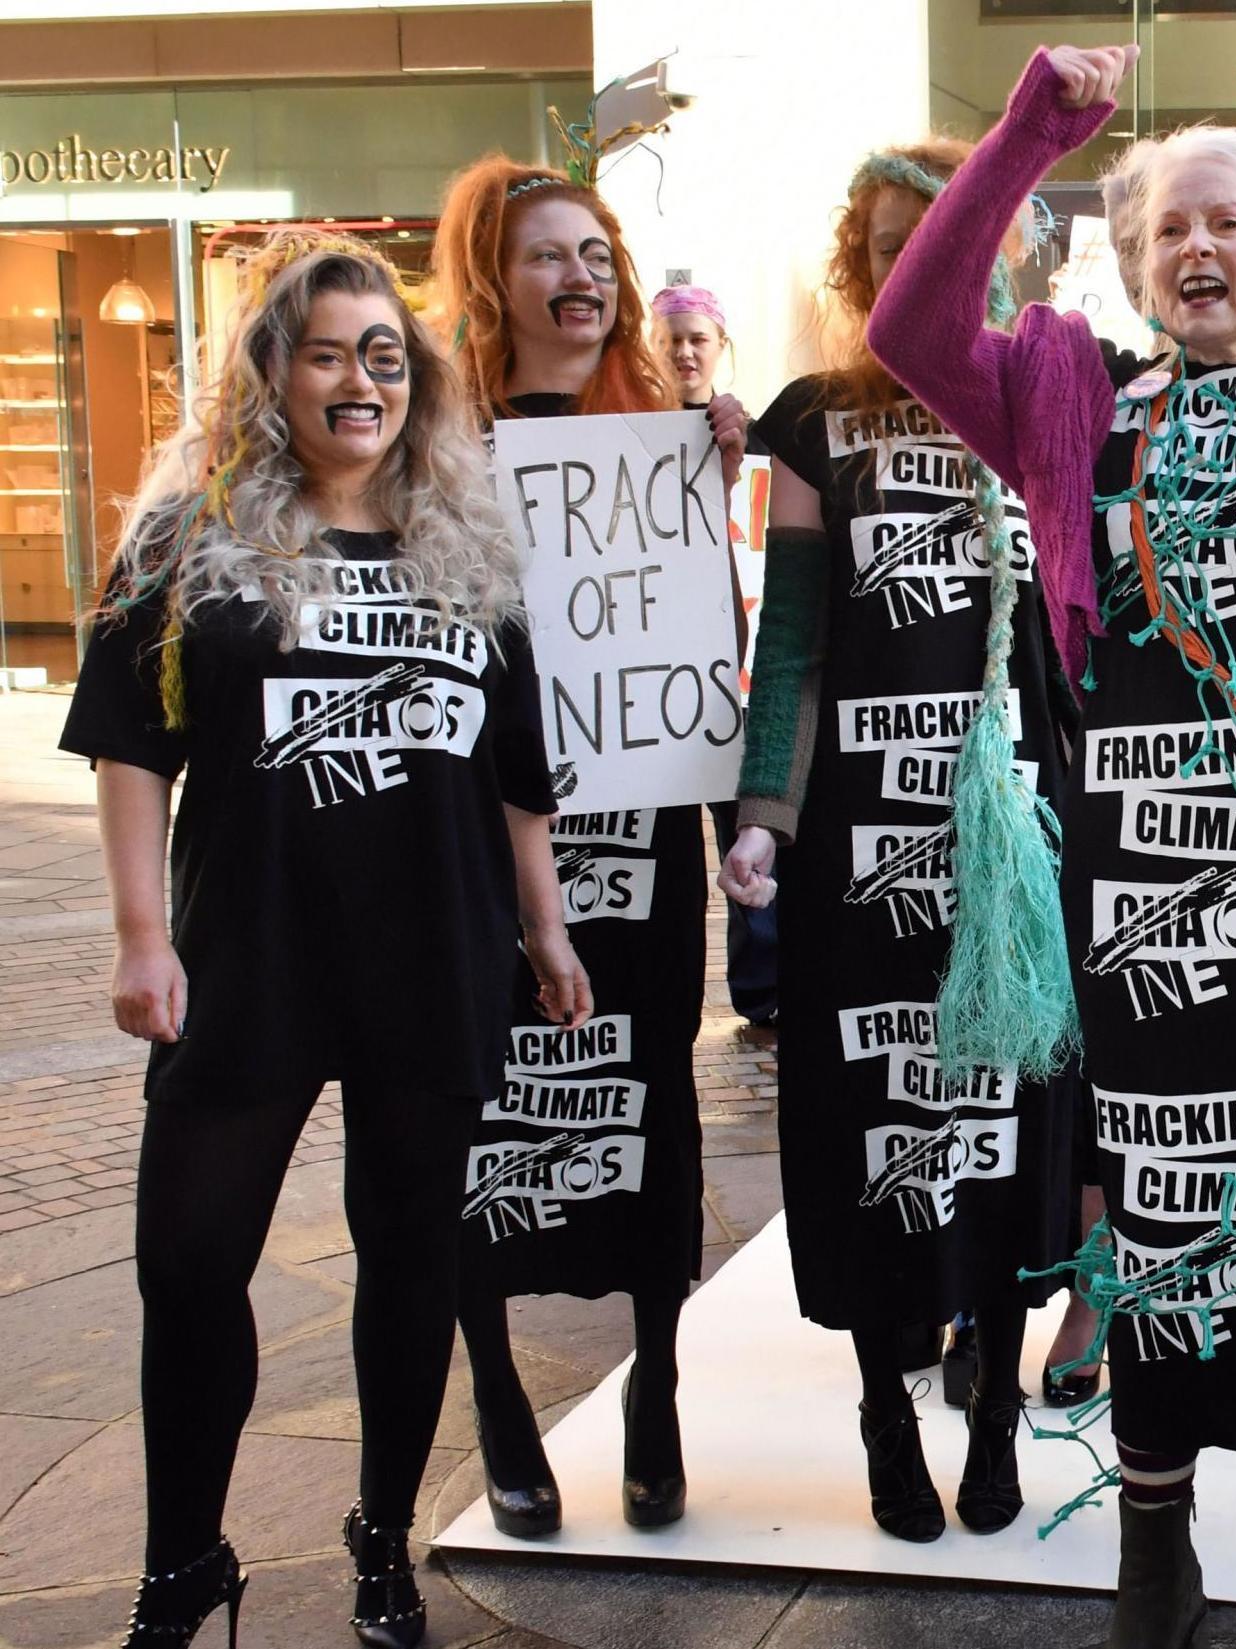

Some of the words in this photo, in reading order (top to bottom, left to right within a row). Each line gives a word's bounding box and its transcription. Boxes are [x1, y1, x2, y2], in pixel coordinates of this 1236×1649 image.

[0, 134, 230, 195] pothecary
[514, 442, 718, 558] FRACK
[568, 564, 662, 641] OFF
[881, 571, 973, 630] INE
[318, 608, 478, 664] CLIMATE
[300, 746, 409, 810] INE
[1121, 950, 1228, 1021] INE
[498, 1080, 631, 1121] CLIMATE
[483, 1196, 568, 1245] INE
